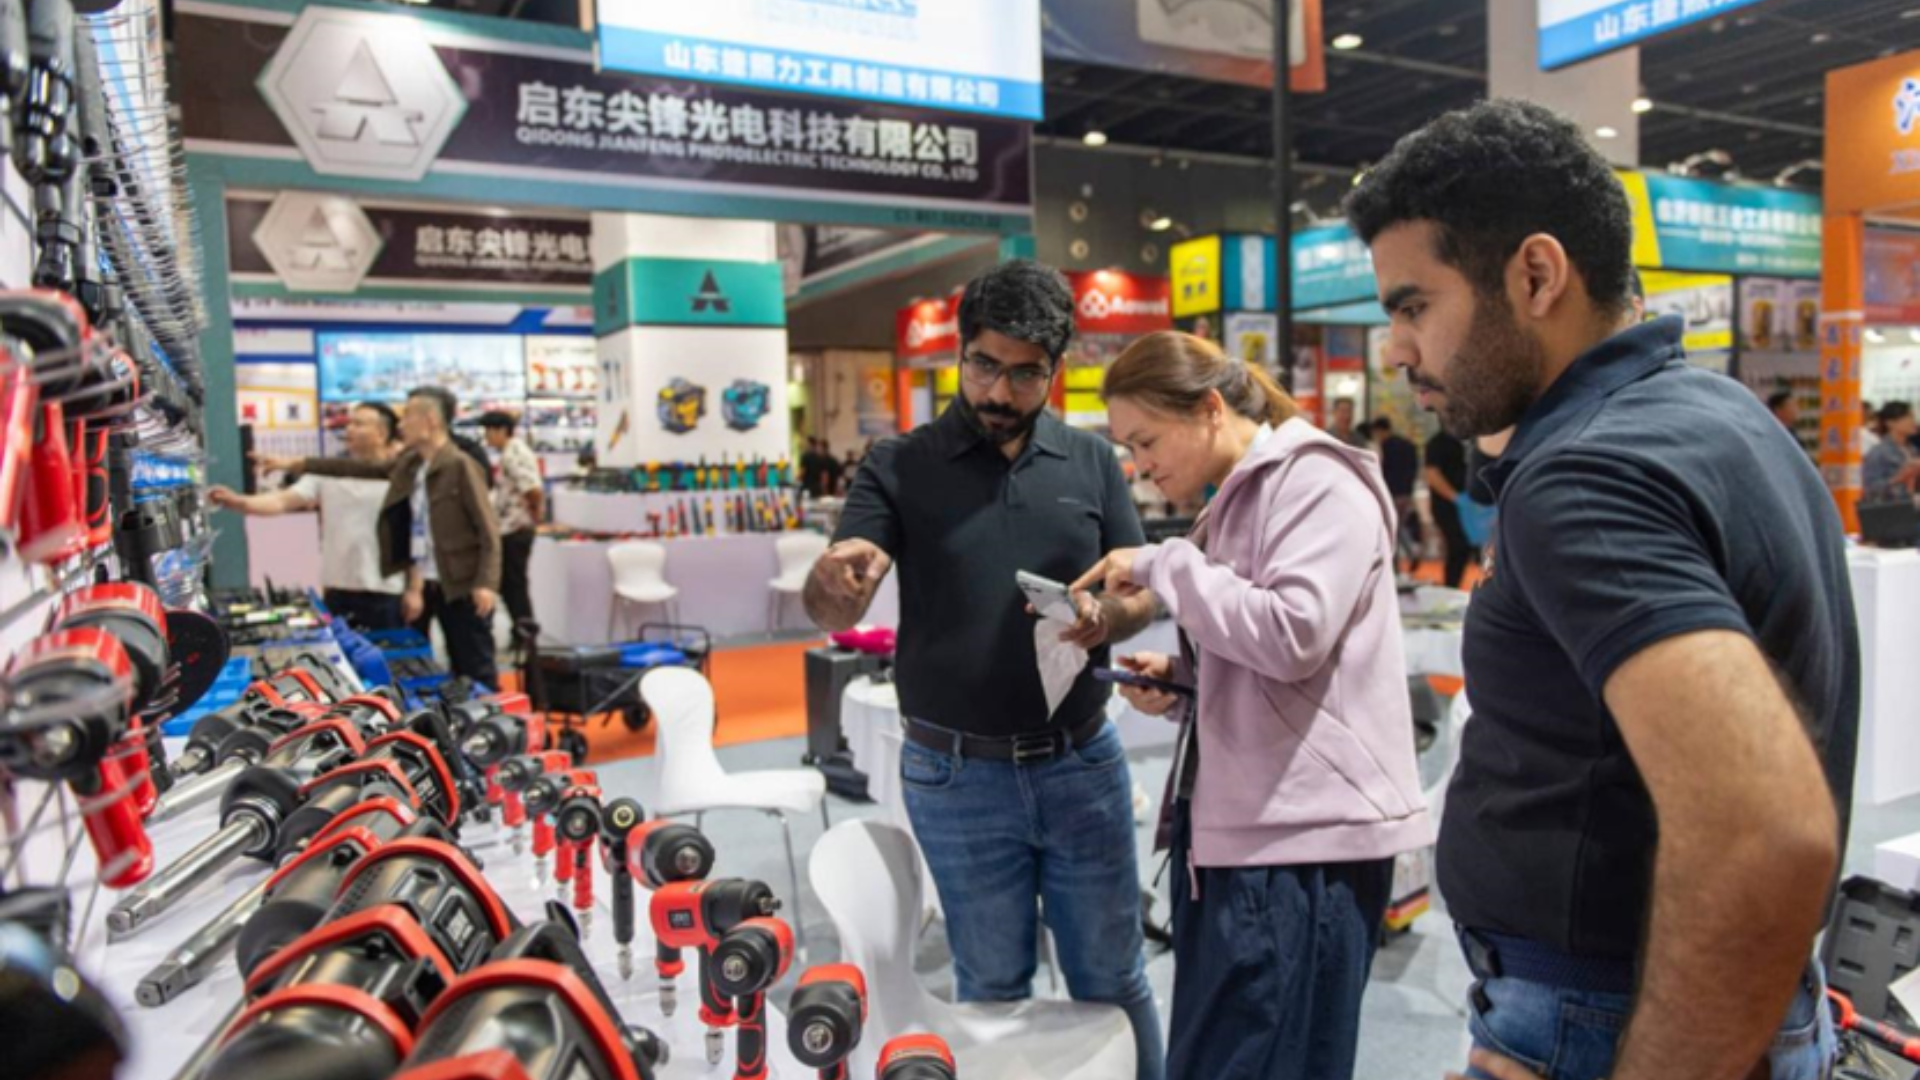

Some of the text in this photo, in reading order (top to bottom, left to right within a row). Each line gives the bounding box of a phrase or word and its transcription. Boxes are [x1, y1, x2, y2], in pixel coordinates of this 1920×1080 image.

[516, 81, 978, 165] 启东尖锋光电科技有限公司
[516, 126, 595, 149] QIDONG
[598, 134, 686, 157] JIANFENG
[689, 143, 817, 169] PHOTOELECTRIC
[820, 154, 919, 177] TECHNOLOGY
[416, 225, 590, 261] 启东尖锋光电
